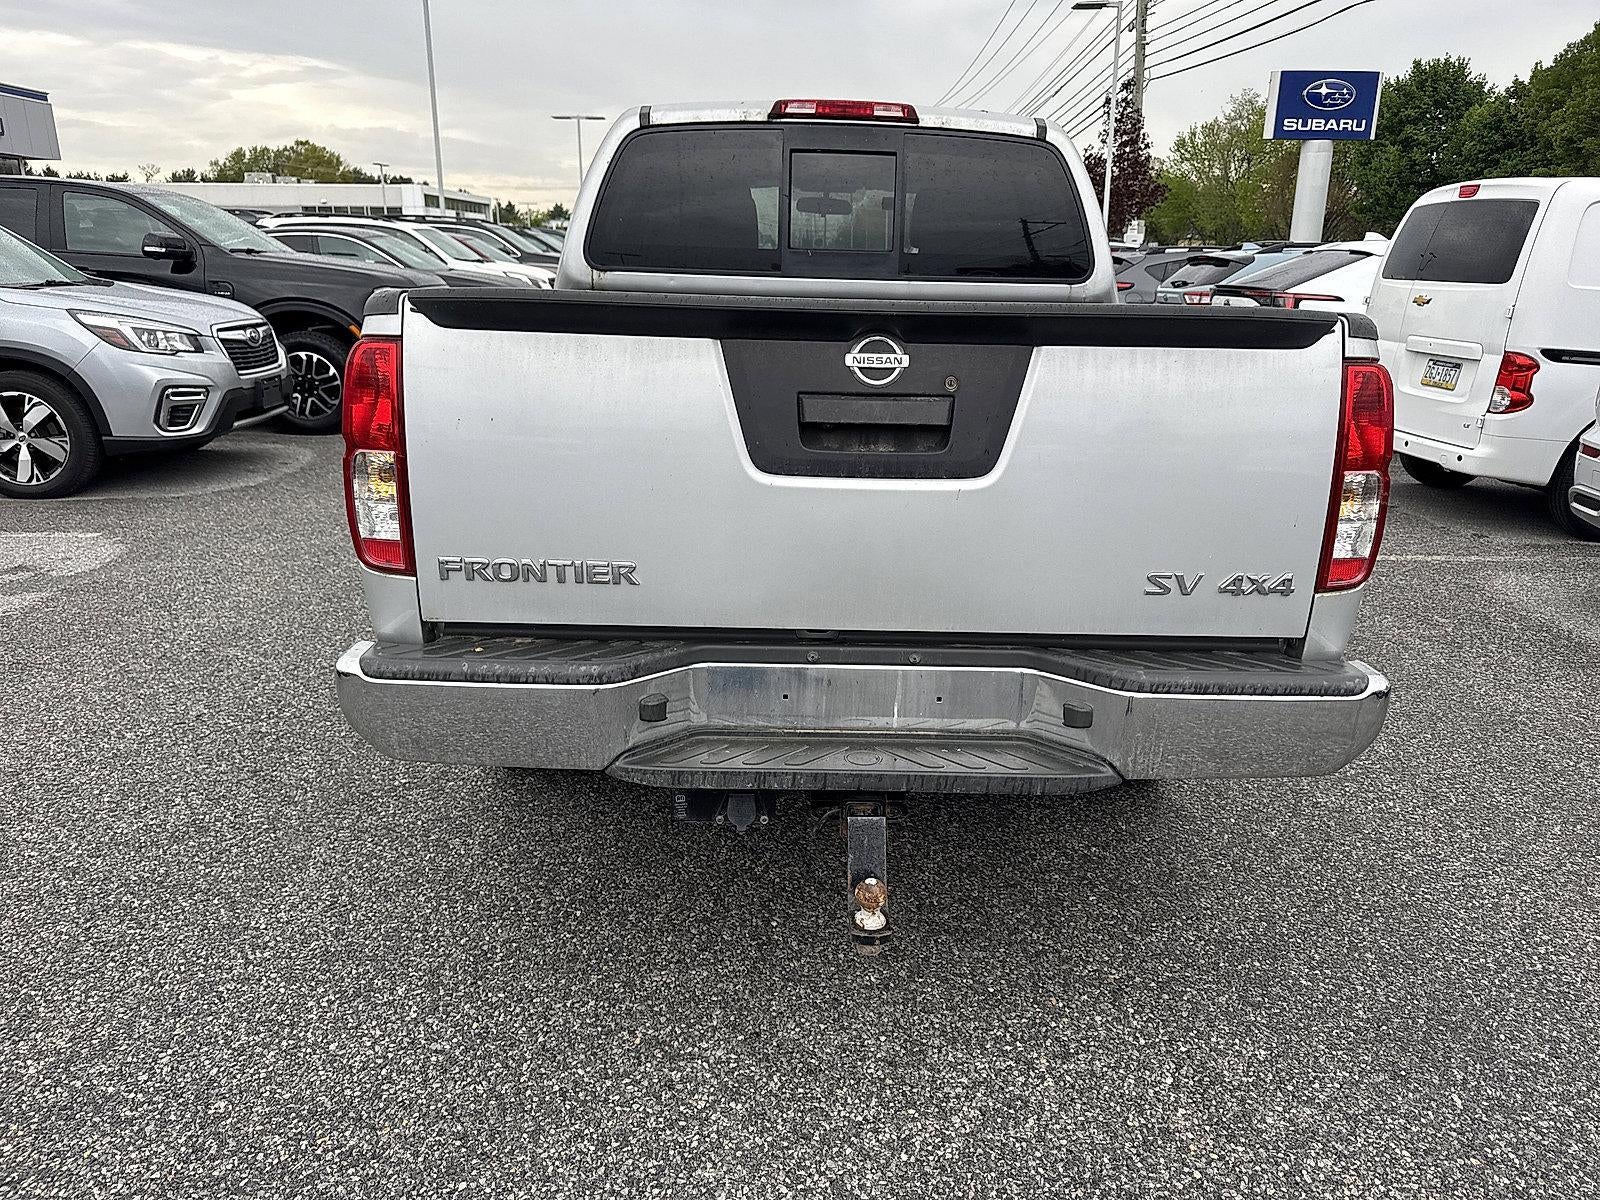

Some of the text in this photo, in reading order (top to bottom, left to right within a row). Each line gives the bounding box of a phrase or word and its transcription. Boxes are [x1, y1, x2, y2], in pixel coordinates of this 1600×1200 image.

[1282, 118, 1366, 132] SUBARU
[852, 356, 903, 365] NISSAN
[437, 556, 641, 586] FRONTIER
[1144, 571, 1206, 596] SV
